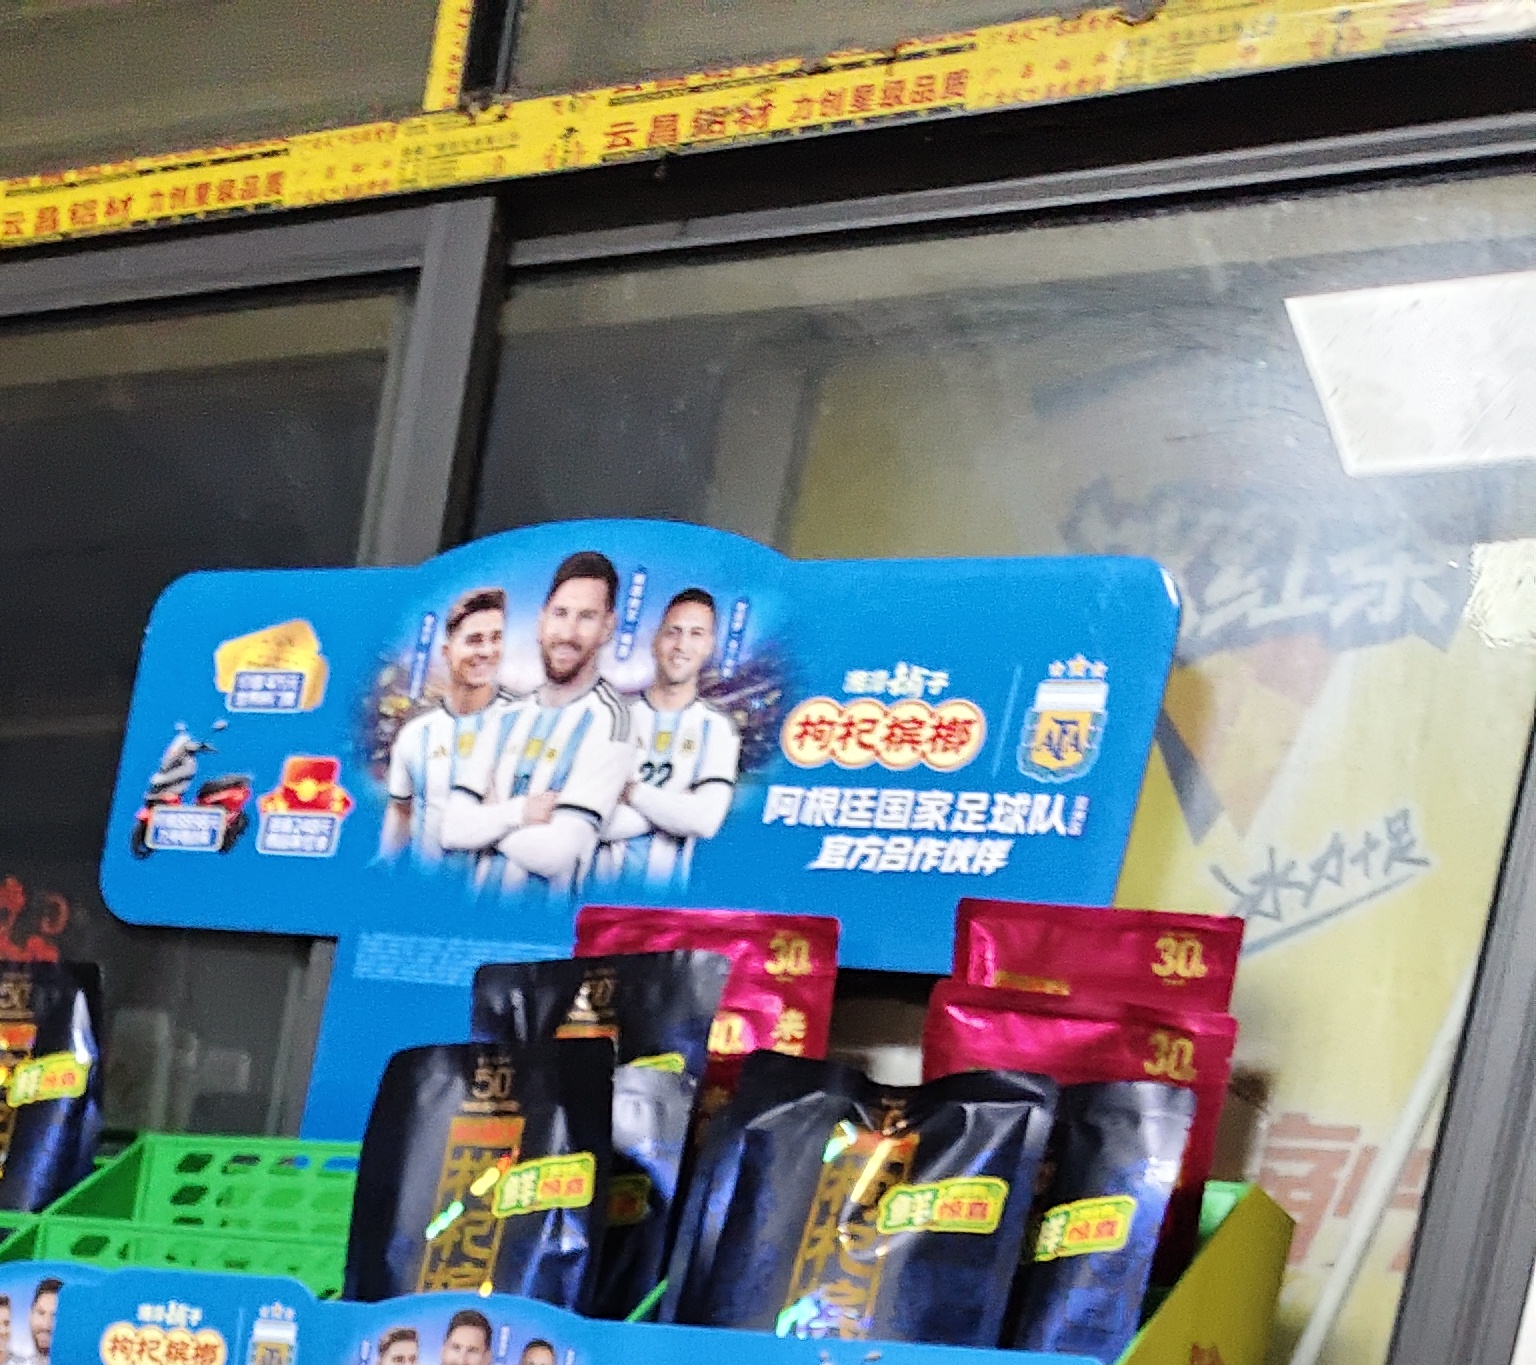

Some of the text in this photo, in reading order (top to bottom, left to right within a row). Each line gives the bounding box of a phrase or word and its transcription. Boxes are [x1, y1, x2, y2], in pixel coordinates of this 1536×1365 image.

[794, 712, 978, 757] 枸杞槟榔
[763, 785, 1069, 836] 阿根廷国家足球队
[806, 834, 1015, 876] 官方合作伙伴
